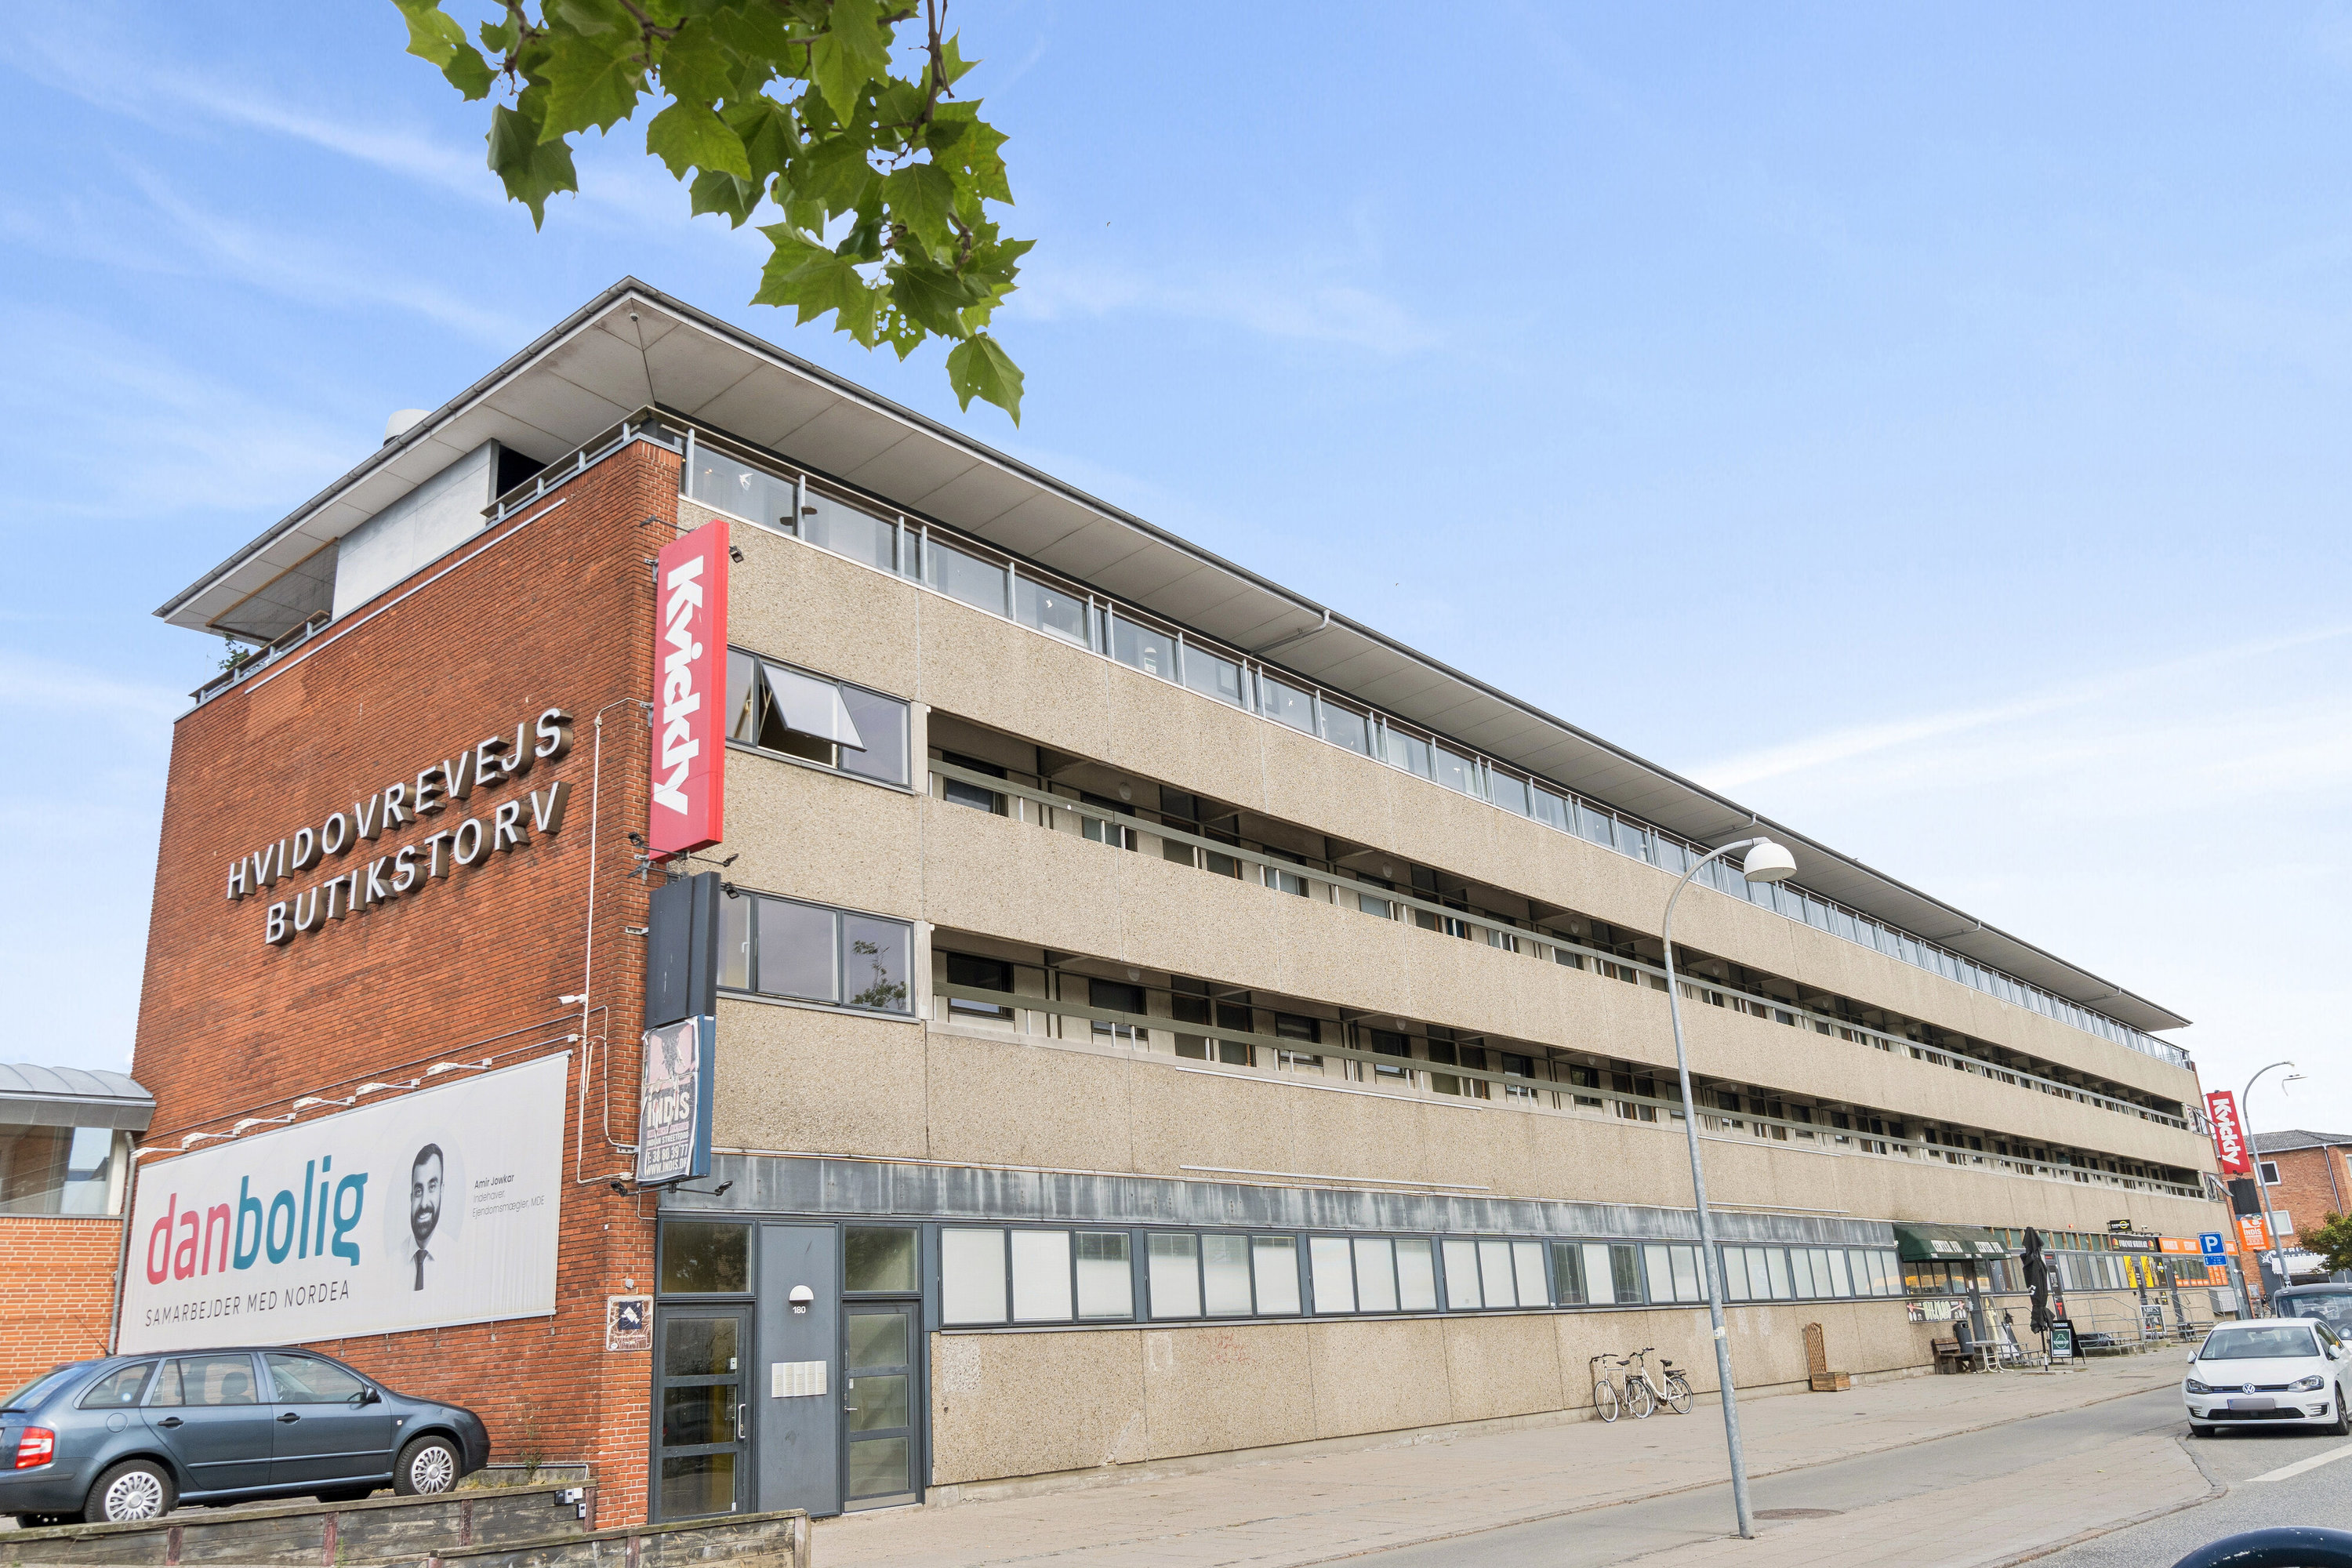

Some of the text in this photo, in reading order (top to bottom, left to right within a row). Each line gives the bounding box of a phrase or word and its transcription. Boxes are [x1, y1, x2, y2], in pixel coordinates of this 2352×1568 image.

[654, 555, 704, 815] Kvickly
[227, 708, 573, 900] HVIDOVREVEJS
[266, 781, 572, 946] BUTIKSTORV
[474, 1174, 515, 1189] Amir Jowkar
[531, 1195, 546, 1207] MDE
[147, 1155, 368, 1285] danbolig
[2205, 1236, 2218, 1252] P
[145, 1279, 350, 1327] SAMARBEJDER MED NORDEA
[793, 1305, 806, 1314] 180
